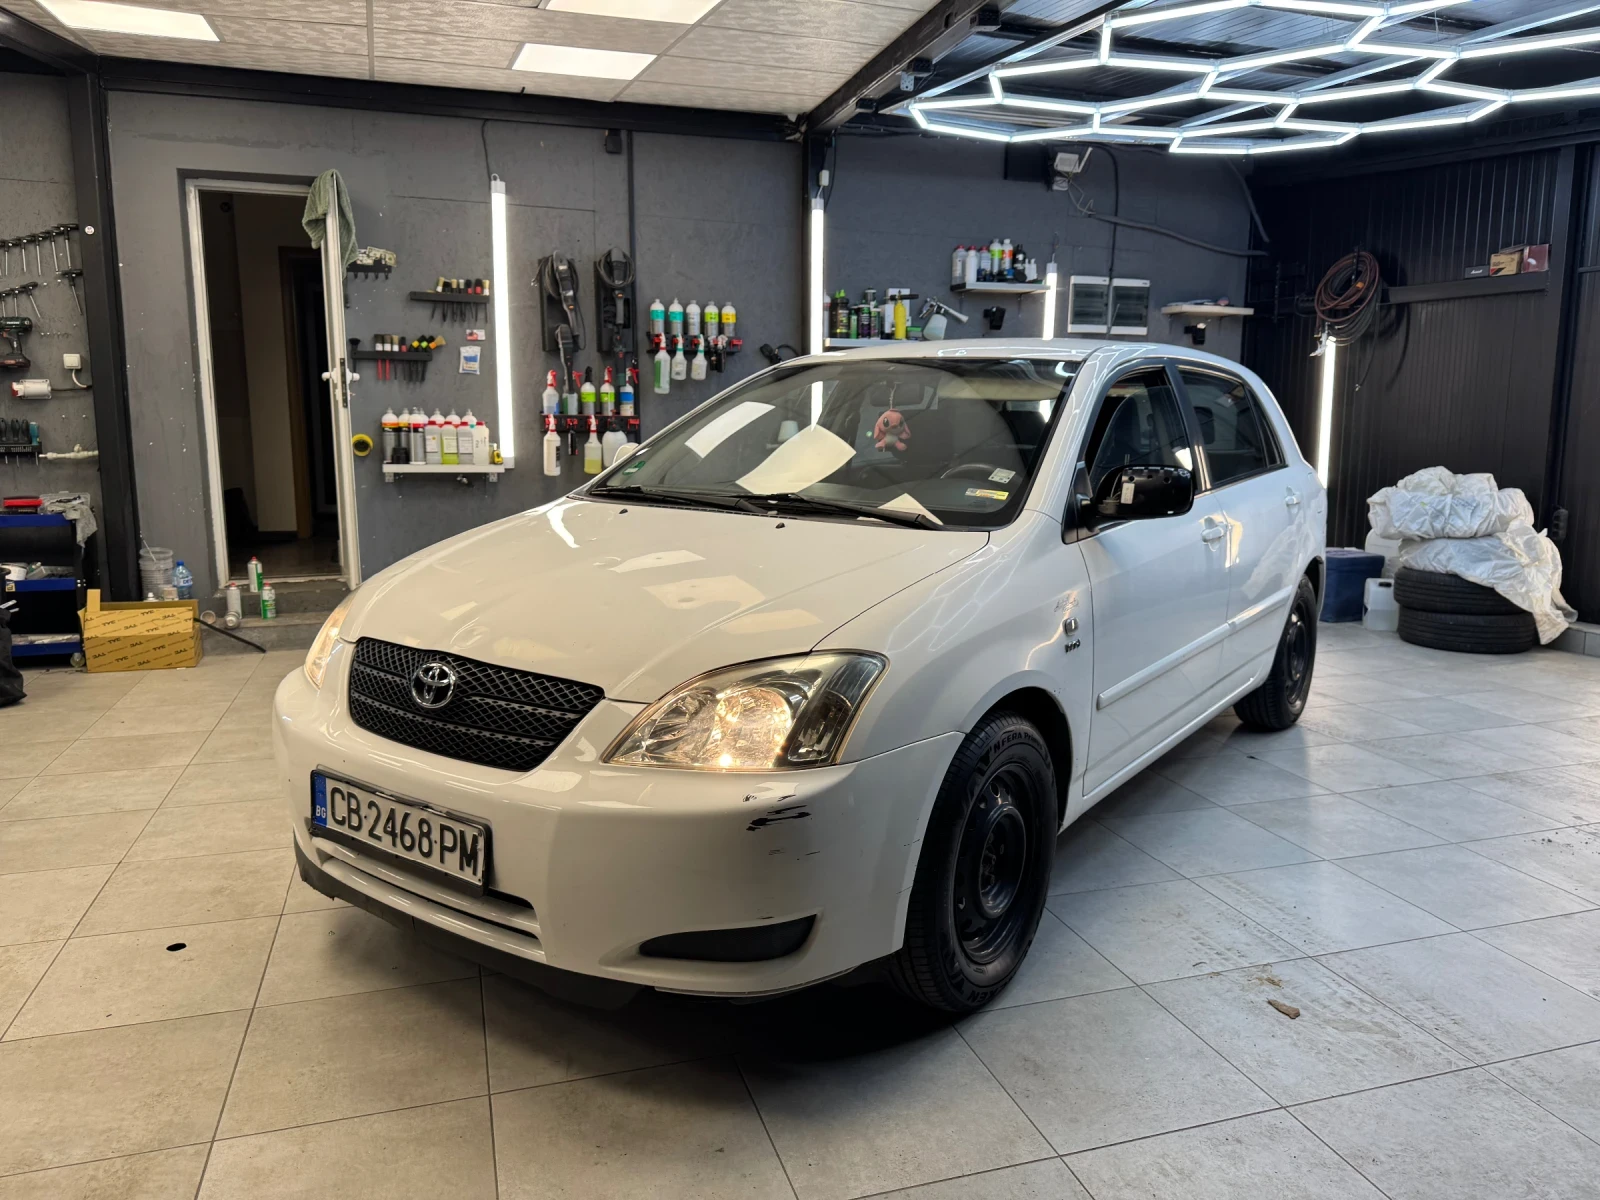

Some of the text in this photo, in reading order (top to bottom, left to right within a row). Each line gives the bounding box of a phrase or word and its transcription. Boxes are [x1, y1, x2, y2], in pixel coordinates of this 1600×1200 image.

[315, 804, 327, 819] BG
[330, 786, 479, 876] CB 2468 PM
